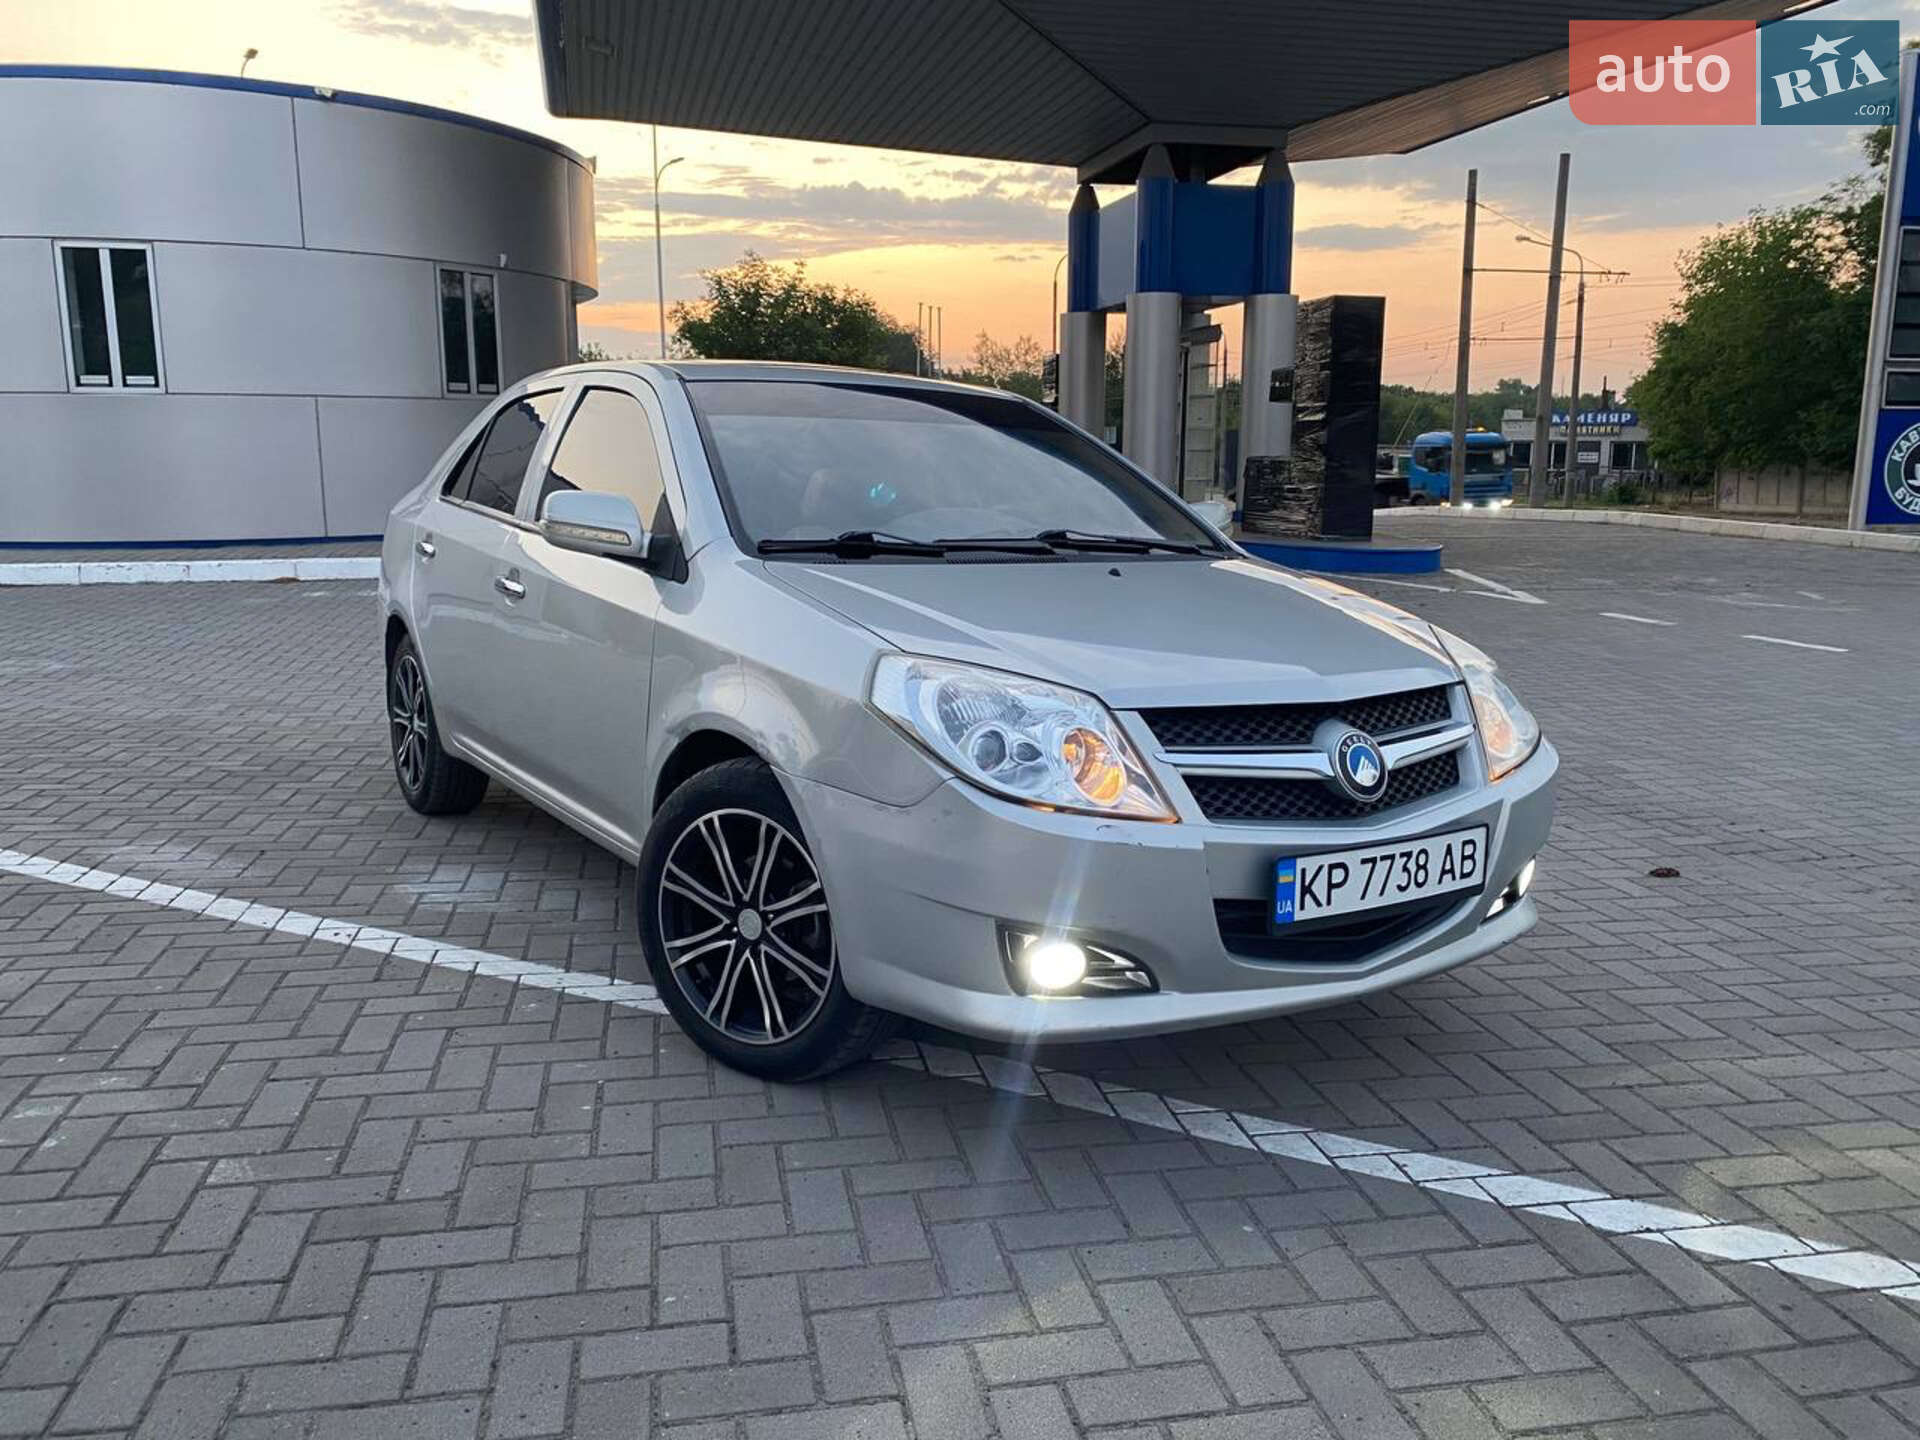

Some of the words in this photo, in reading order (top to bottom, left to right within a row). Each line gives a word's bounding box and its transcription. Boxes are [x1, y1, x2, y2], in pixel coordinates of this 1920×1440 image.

[1891, 426, 1920, 462] КАВ
[1299, 862, 1350, 912] KP
[1360, 848, 1429, 901] 7738
[1437, 839, 1477, 886] AB
[1277, 900, 1293, 914] UA
